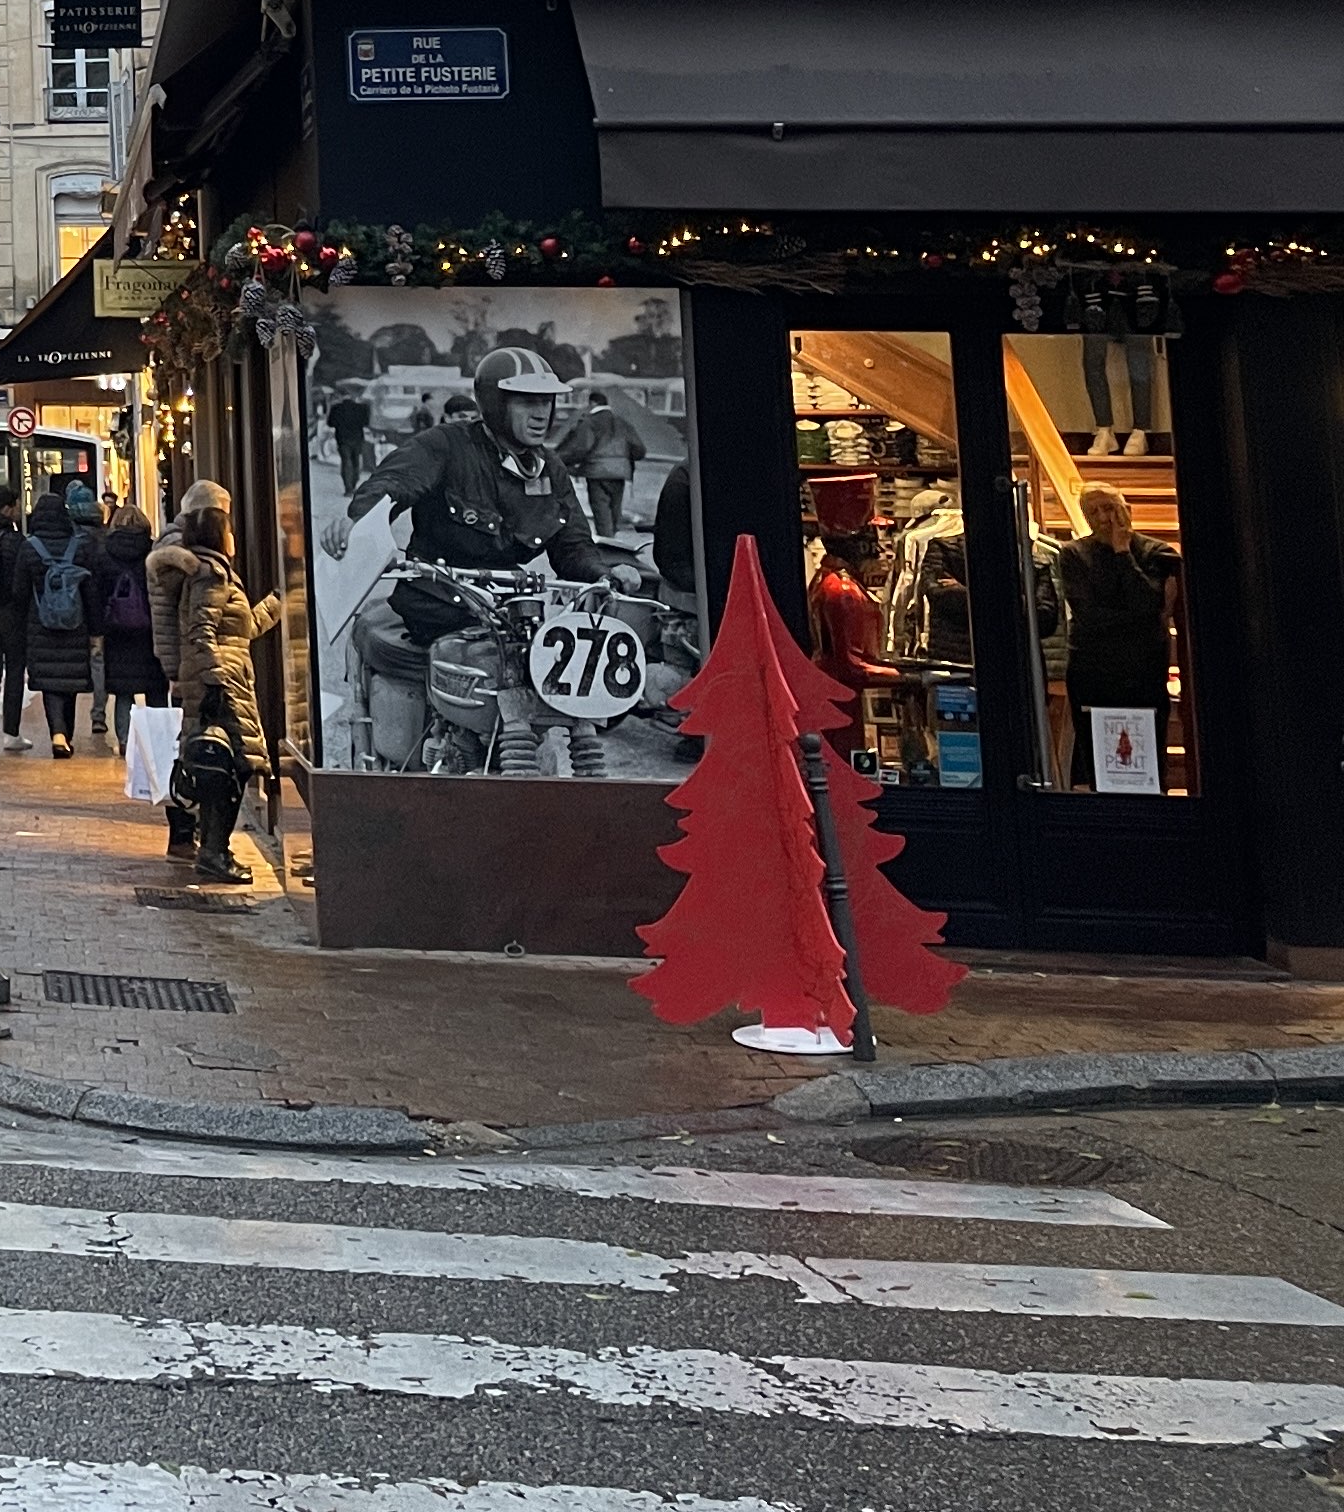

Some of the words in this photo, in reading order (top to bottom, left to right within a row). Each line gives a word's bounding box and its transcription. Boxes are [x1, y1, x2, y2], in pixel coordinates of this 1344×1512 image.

[59, 7, 137, 17] PATISSERIE
[413, 37, 441, 48] RUE
[411, 55, 426, 64] DE
[429, 54, 444, 63] LA
[361, 68, 416, 82] PETITE
[421, 67, 497, 81] FUSTERIE
[400, 85, 411, 94] de
[414, 85, 422, 94] la
[17, 355, 30, 363] LA
[542, 626, 641, 699] 278
